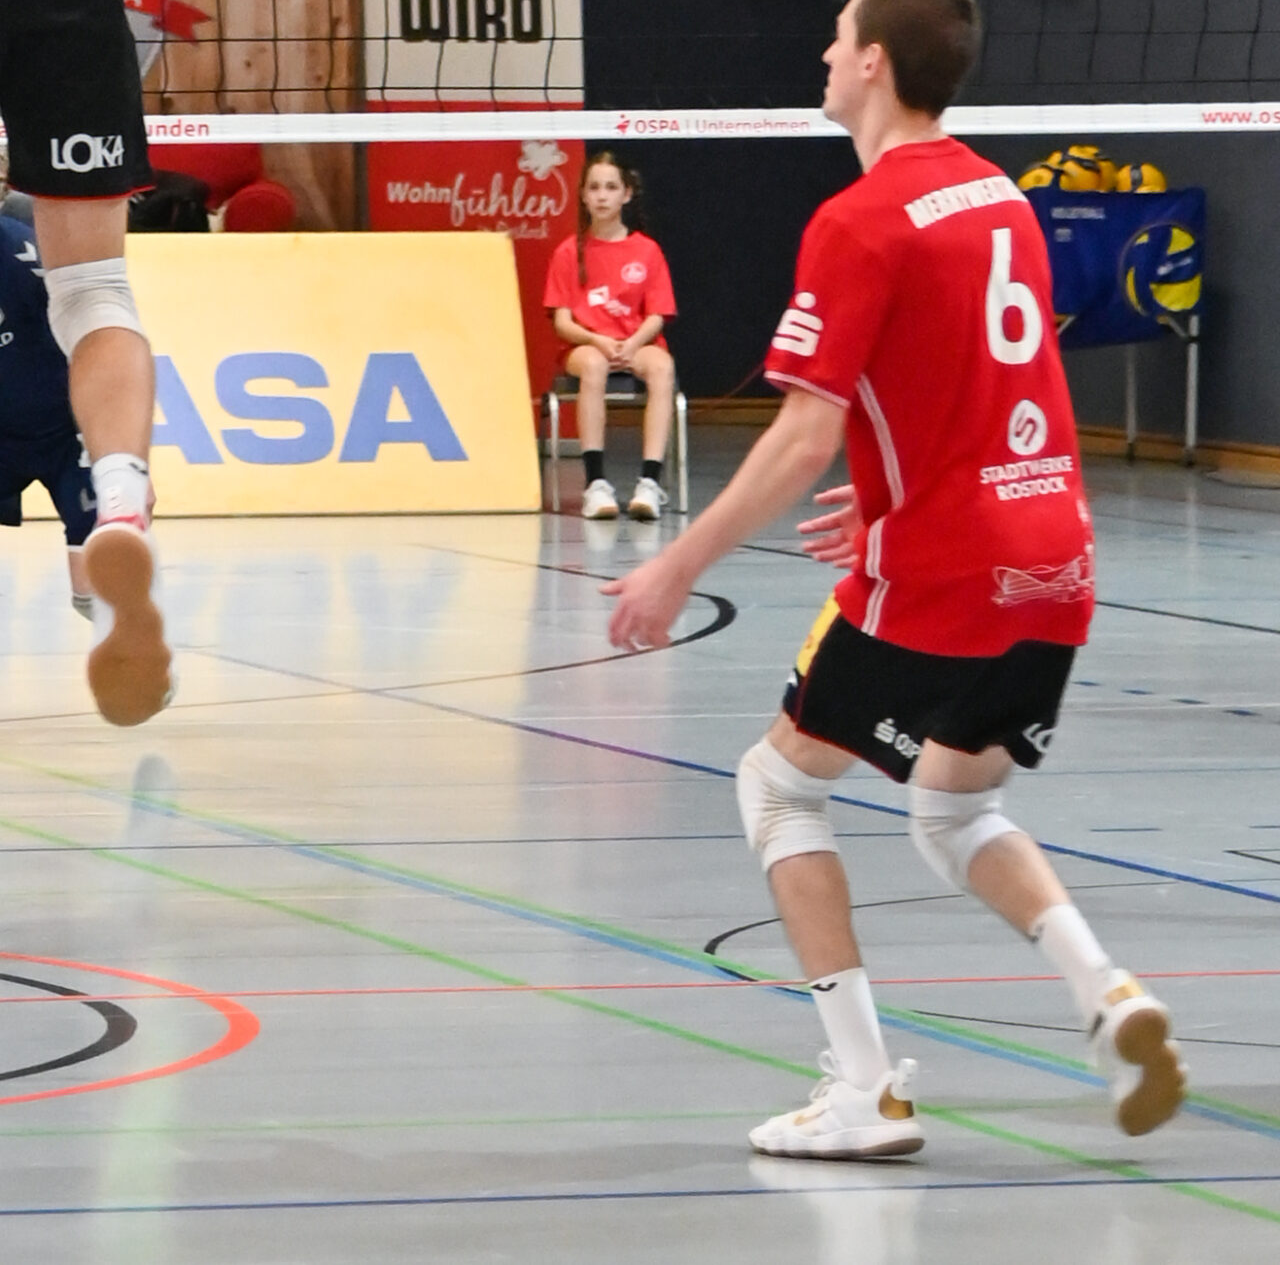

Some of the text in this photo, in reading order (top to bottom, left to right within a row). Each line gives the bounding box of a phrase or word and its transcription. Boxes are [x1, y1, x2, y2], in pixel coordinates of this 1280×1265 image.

[634, 118, 810, 134] OSPA Unternehmen
[985, 228, 1042, 365] 6
